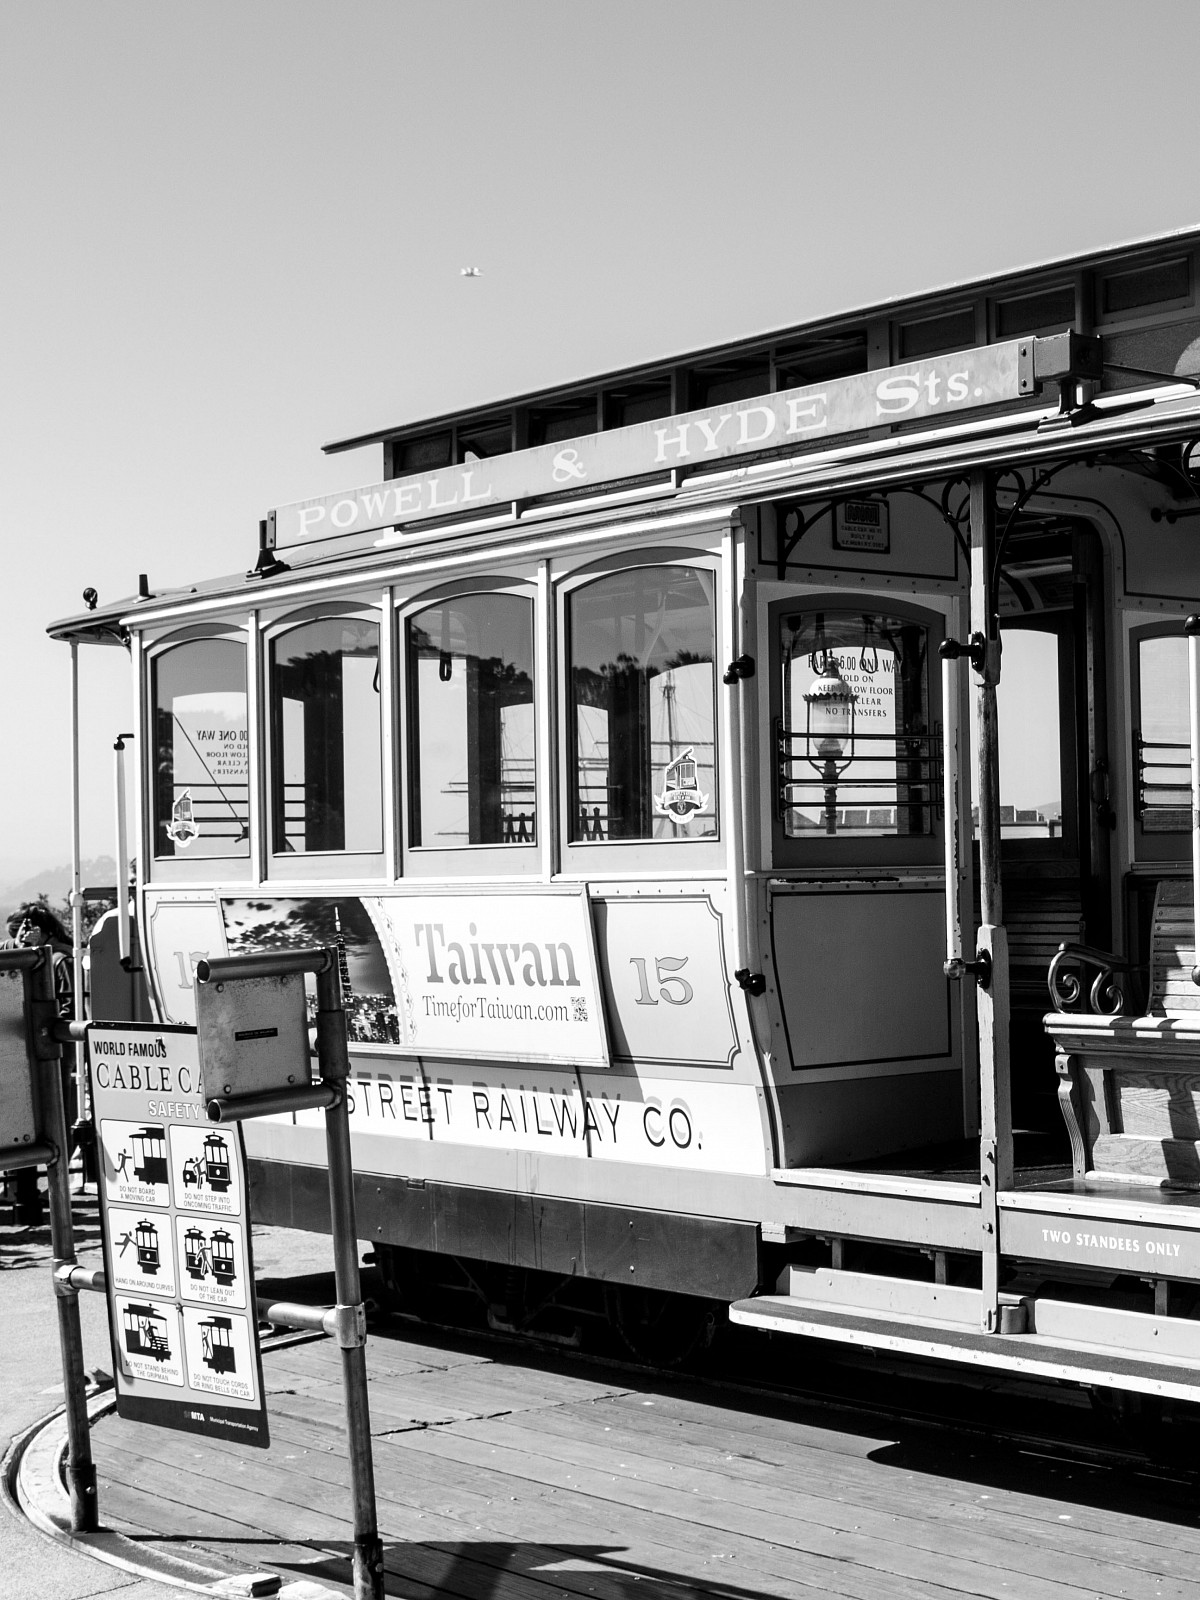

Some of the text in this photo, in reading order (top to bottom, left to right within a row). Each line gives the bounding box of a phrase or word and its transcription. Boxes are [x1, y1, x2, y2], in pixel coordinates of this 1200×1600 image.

[297, 369, 983, 537] POWELL & HYDE Sts.
[869, 687, 893, 695] FLOOR
[825, 707, 887, 717] NO TRANSFERS
[414, 922, 581, 987] Taiwan
[629, 956, 694, 1006] 15
[422, 995, 569, 1023] TimeforTaiwan.com
[93, 1041, 167, 1058] WORLD FAMOUS
[97, 1062, 173, 1092] CABLE
[148, 1100, 200, 1120] SAFETY
[472, 1091, 621, 1143] RAILWAY
[643, 1105, 703, 1150] CO.
[1042, 1229, 1180, 1257] TWO STANDEES ONLY
